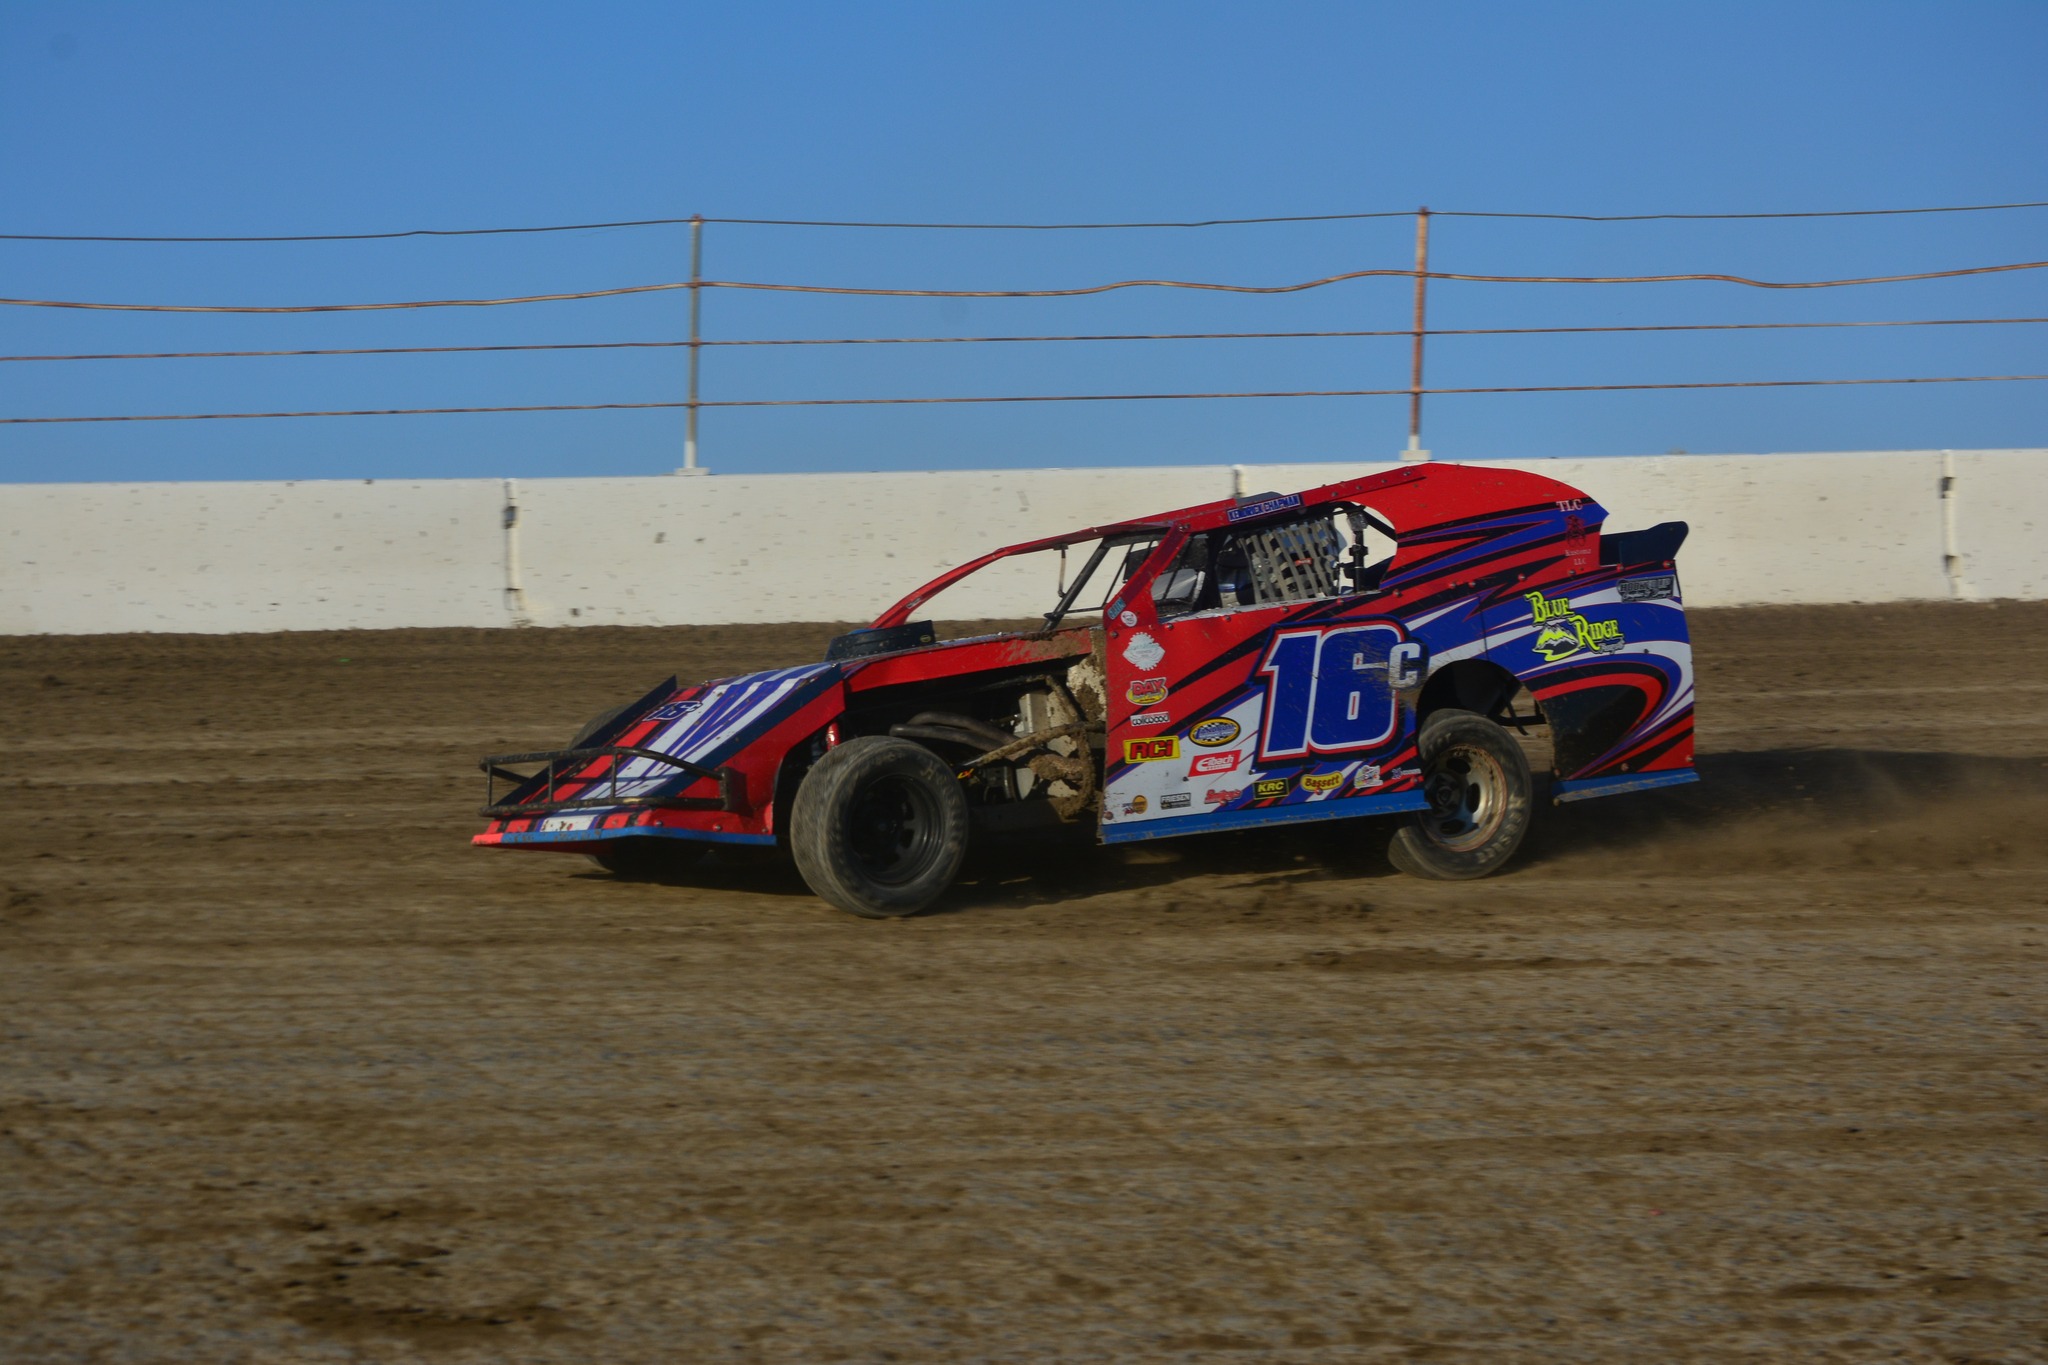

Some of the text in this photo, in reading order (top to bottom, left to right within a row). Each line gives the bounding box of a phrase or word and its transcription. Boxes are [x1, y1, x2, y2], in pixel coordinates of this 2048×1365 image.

[1556, 499, 1583, 512] TLC
[1525, 591, 1574, 623] BLUE
[1568, 615, 1623, 651] RIDGE
[1131, 680, 1164, 696] DAY
[1257, 781, 1285, 793] KRC
[1305, 774, 1340, 787] Bassett
[1161, 794, 1190, 804] FRIESEN
